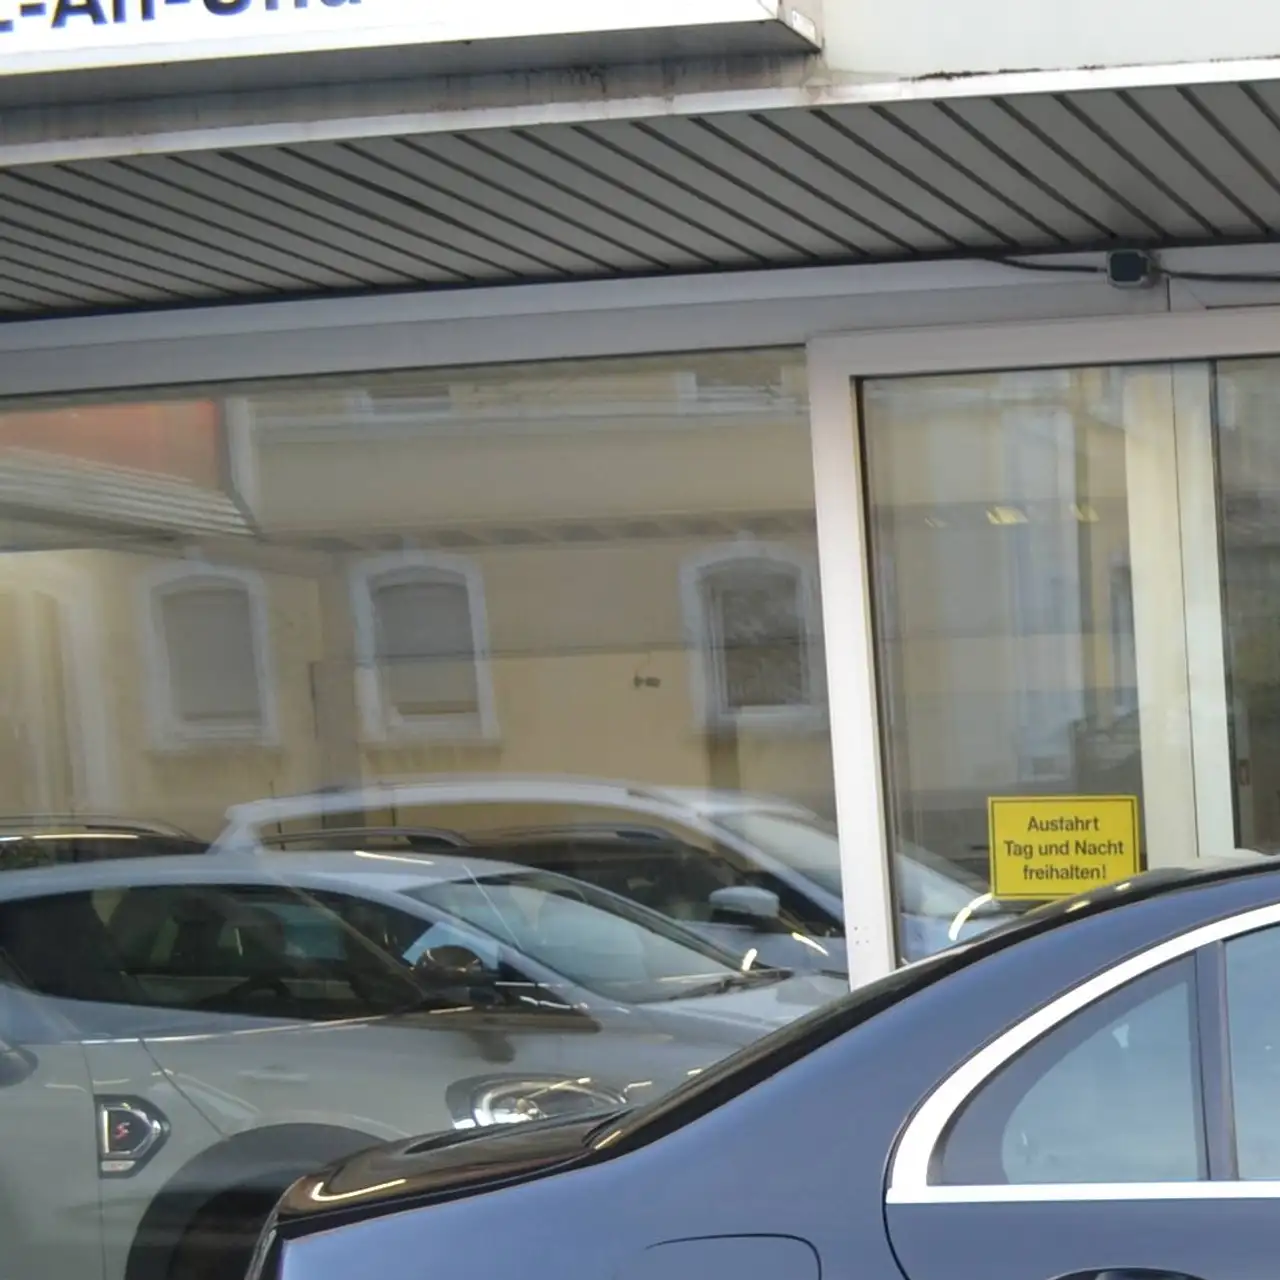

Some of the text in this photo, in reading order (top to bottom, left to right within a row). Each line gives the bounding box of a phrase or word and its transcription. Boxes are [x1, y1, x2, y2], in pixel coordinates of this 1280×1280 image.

[1027, 816, 1100, 832] Ausfahrt
[1004, 840, 1124, 860] Tag und Nacht
[1023, 864, 1107, 881] freihalten!
